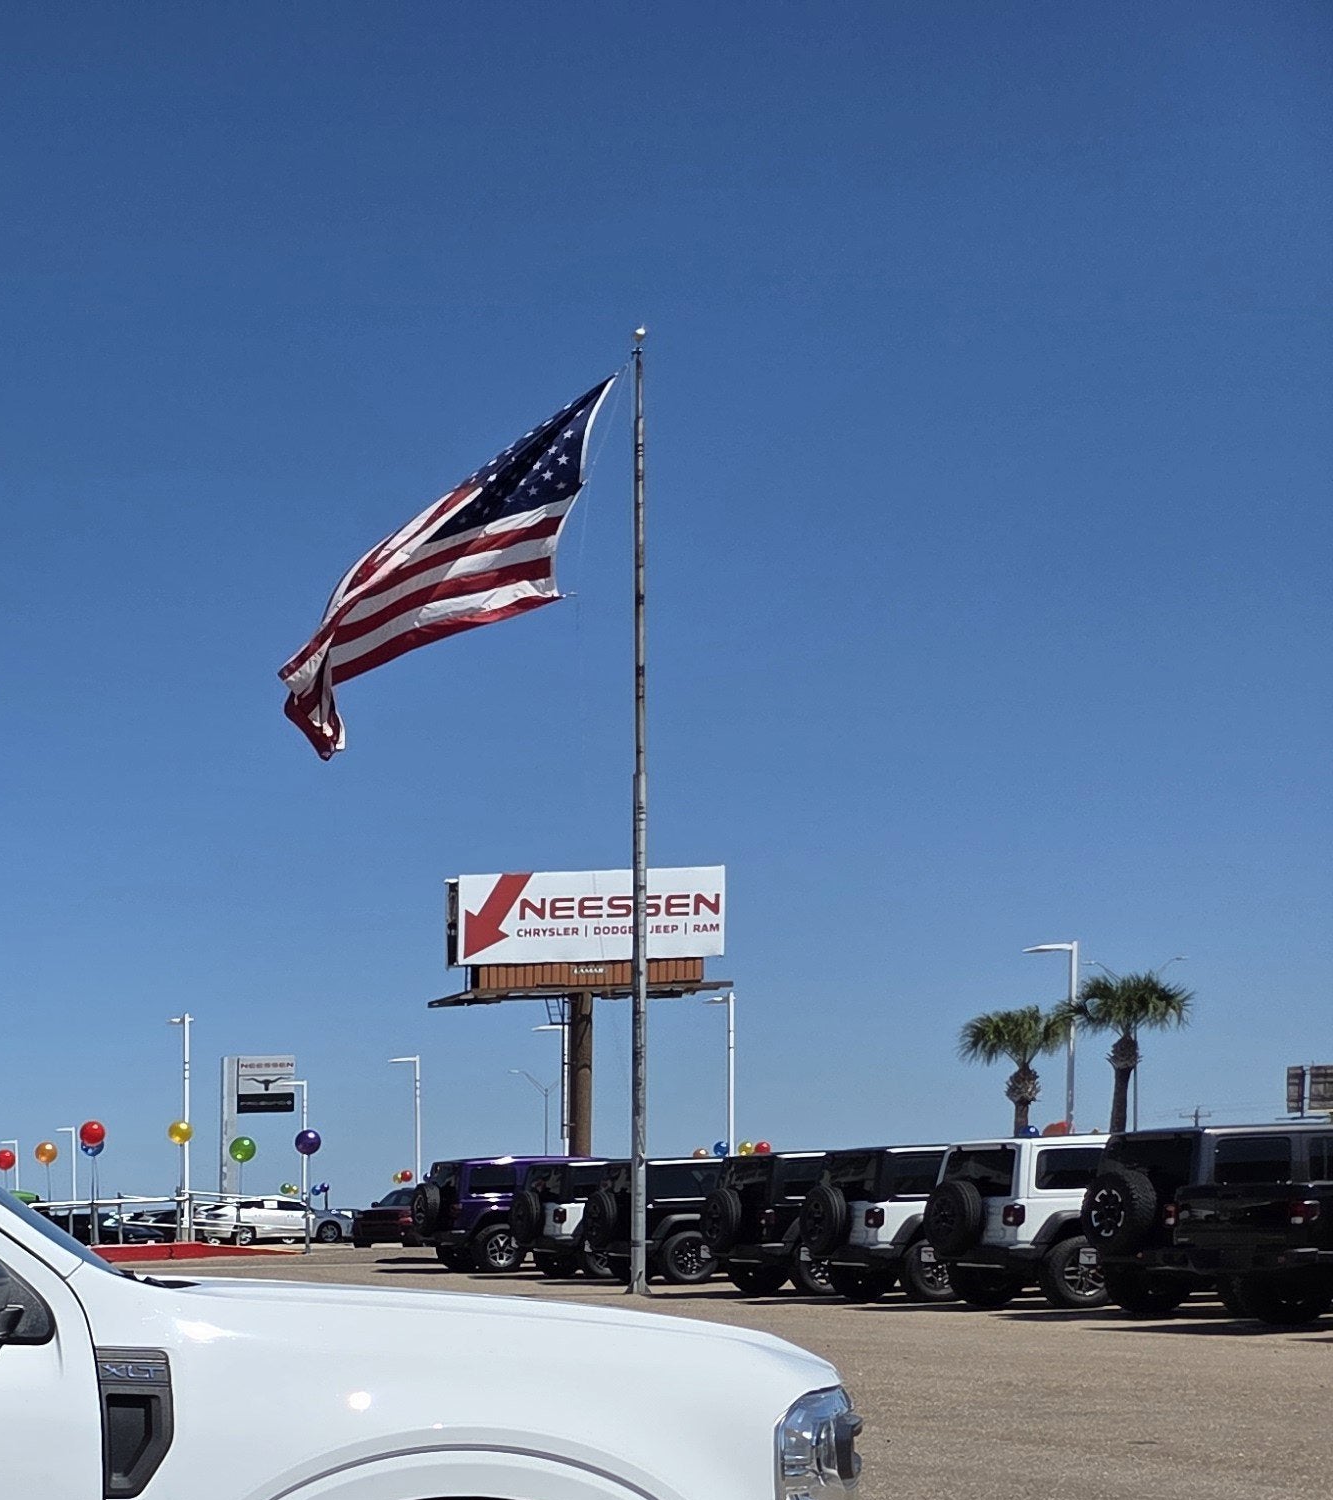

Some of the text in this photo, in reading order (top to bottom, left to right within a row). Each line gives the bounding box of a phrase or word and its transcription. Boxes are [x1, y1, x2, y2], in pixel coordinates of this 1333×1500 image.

[519, 893, 721, 920] NEESSEN
[516, 923, 720, 938] CHRYSLER DODGE JEEP RAM
[101, 1364, 165, 1379] XLT
